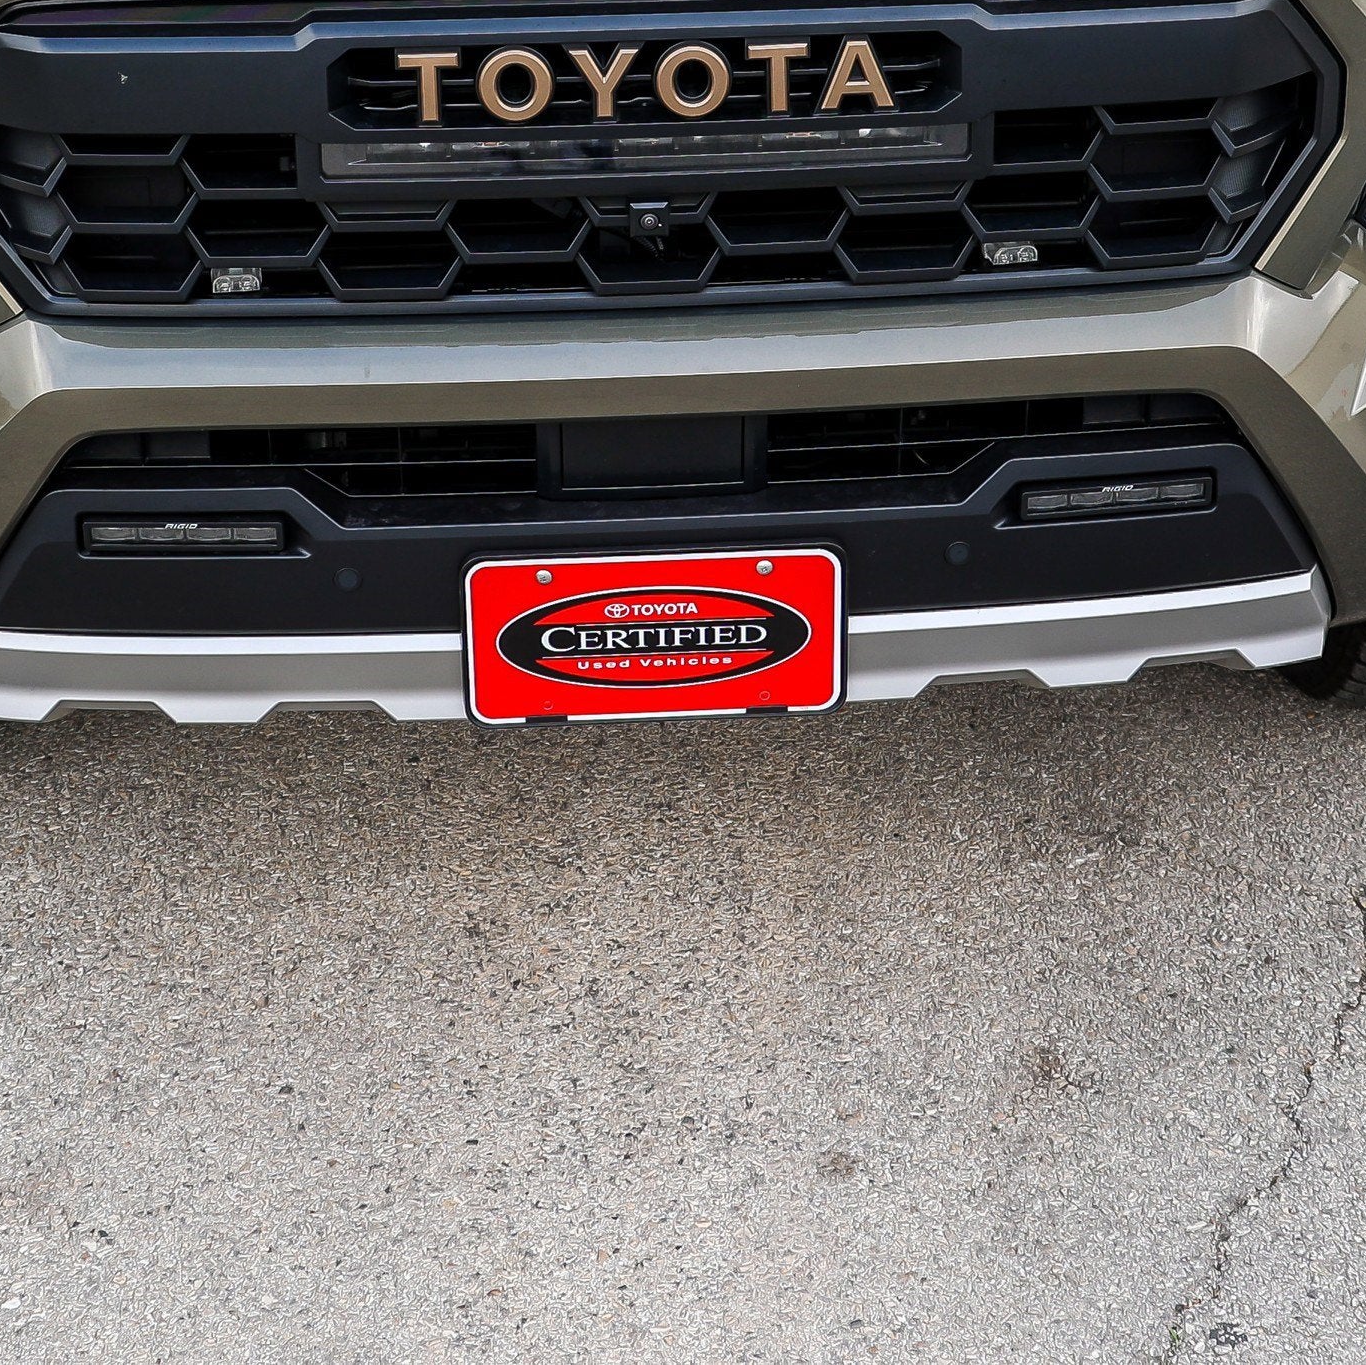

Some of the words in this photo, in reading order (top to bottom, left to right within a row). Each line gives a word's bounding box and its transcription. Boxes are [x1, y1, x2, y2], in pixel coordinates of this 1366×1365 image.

[394, 37, 897, 123] TOYOTA
[631, 602, 698, 616] TOYOTA
[577, 659, 631, 670] Used
[639, 655, 733, 668] Vehicles
